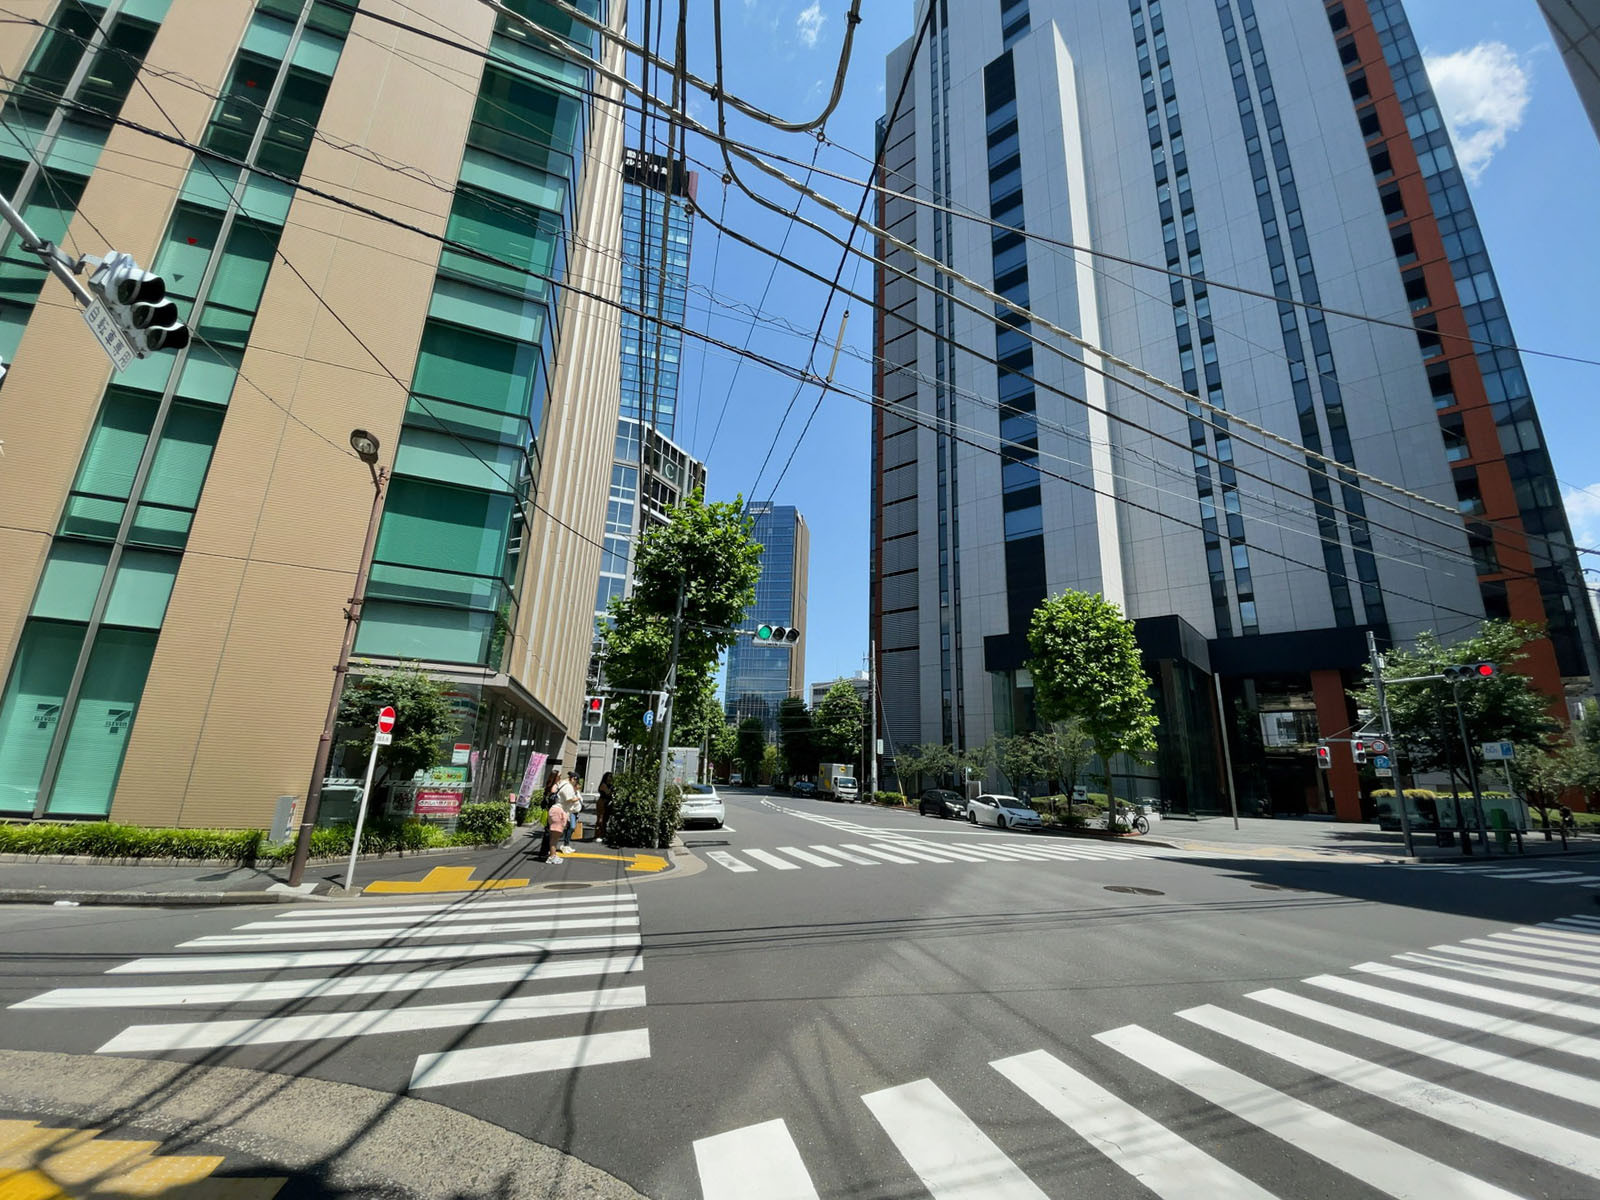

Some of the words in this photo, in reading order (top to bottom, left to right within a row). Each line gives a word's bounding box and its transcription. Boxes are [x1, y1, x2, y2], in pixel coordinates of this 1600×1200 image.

[89, 306, 130, 367] 自転車専用
[665, 463, 675, 479] C
[37, 704, 60, 729] 7
[108, 709, 131, 733] 7
